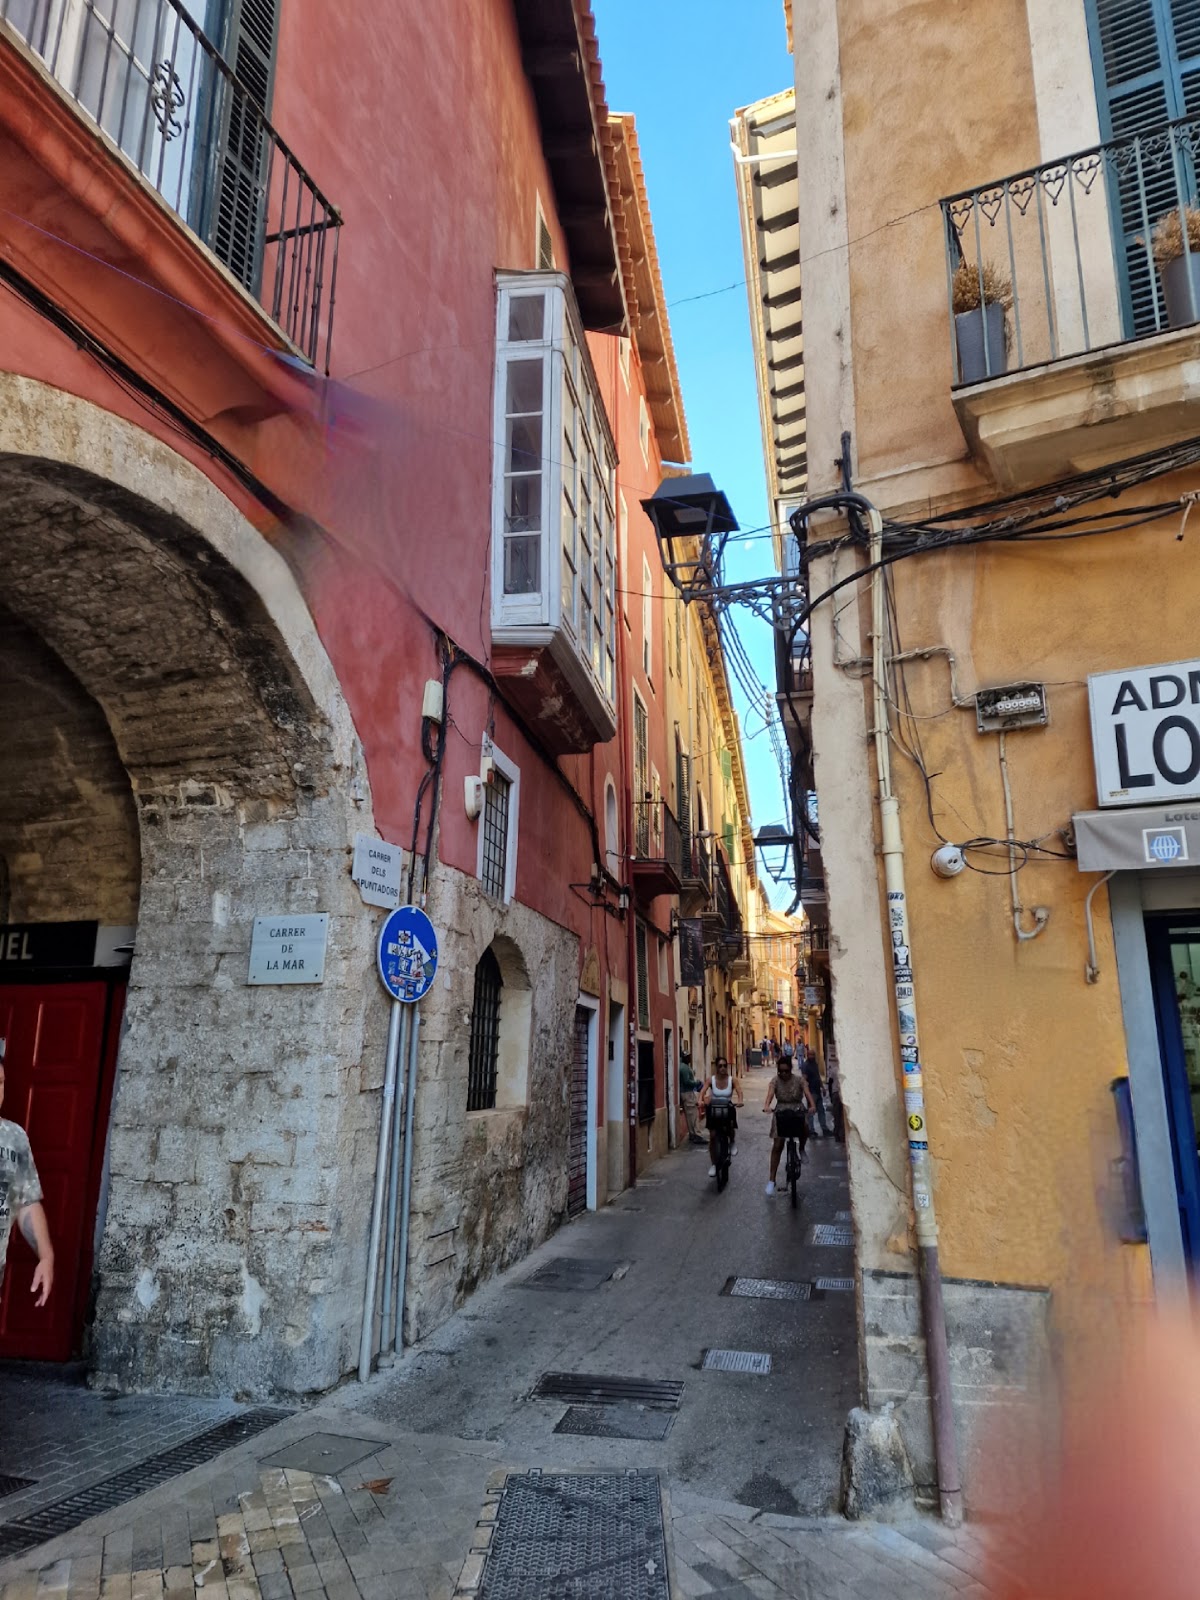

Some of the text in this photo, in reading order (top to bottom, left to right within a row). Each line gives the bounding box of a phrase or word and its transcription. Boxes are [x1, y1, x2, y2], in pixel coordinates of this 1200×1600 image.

[1165, 812, 1200, 822] Lote
[368, 849, 391, 863] CARRER
[371, 865, 386, 878] DELS
[356, 878, 399, 897] APUNTADORS
[269, 927, 306, 938] CARRER
[281, 944, 294, 953] DE
[266, 959, 305, 970] LA MAR
